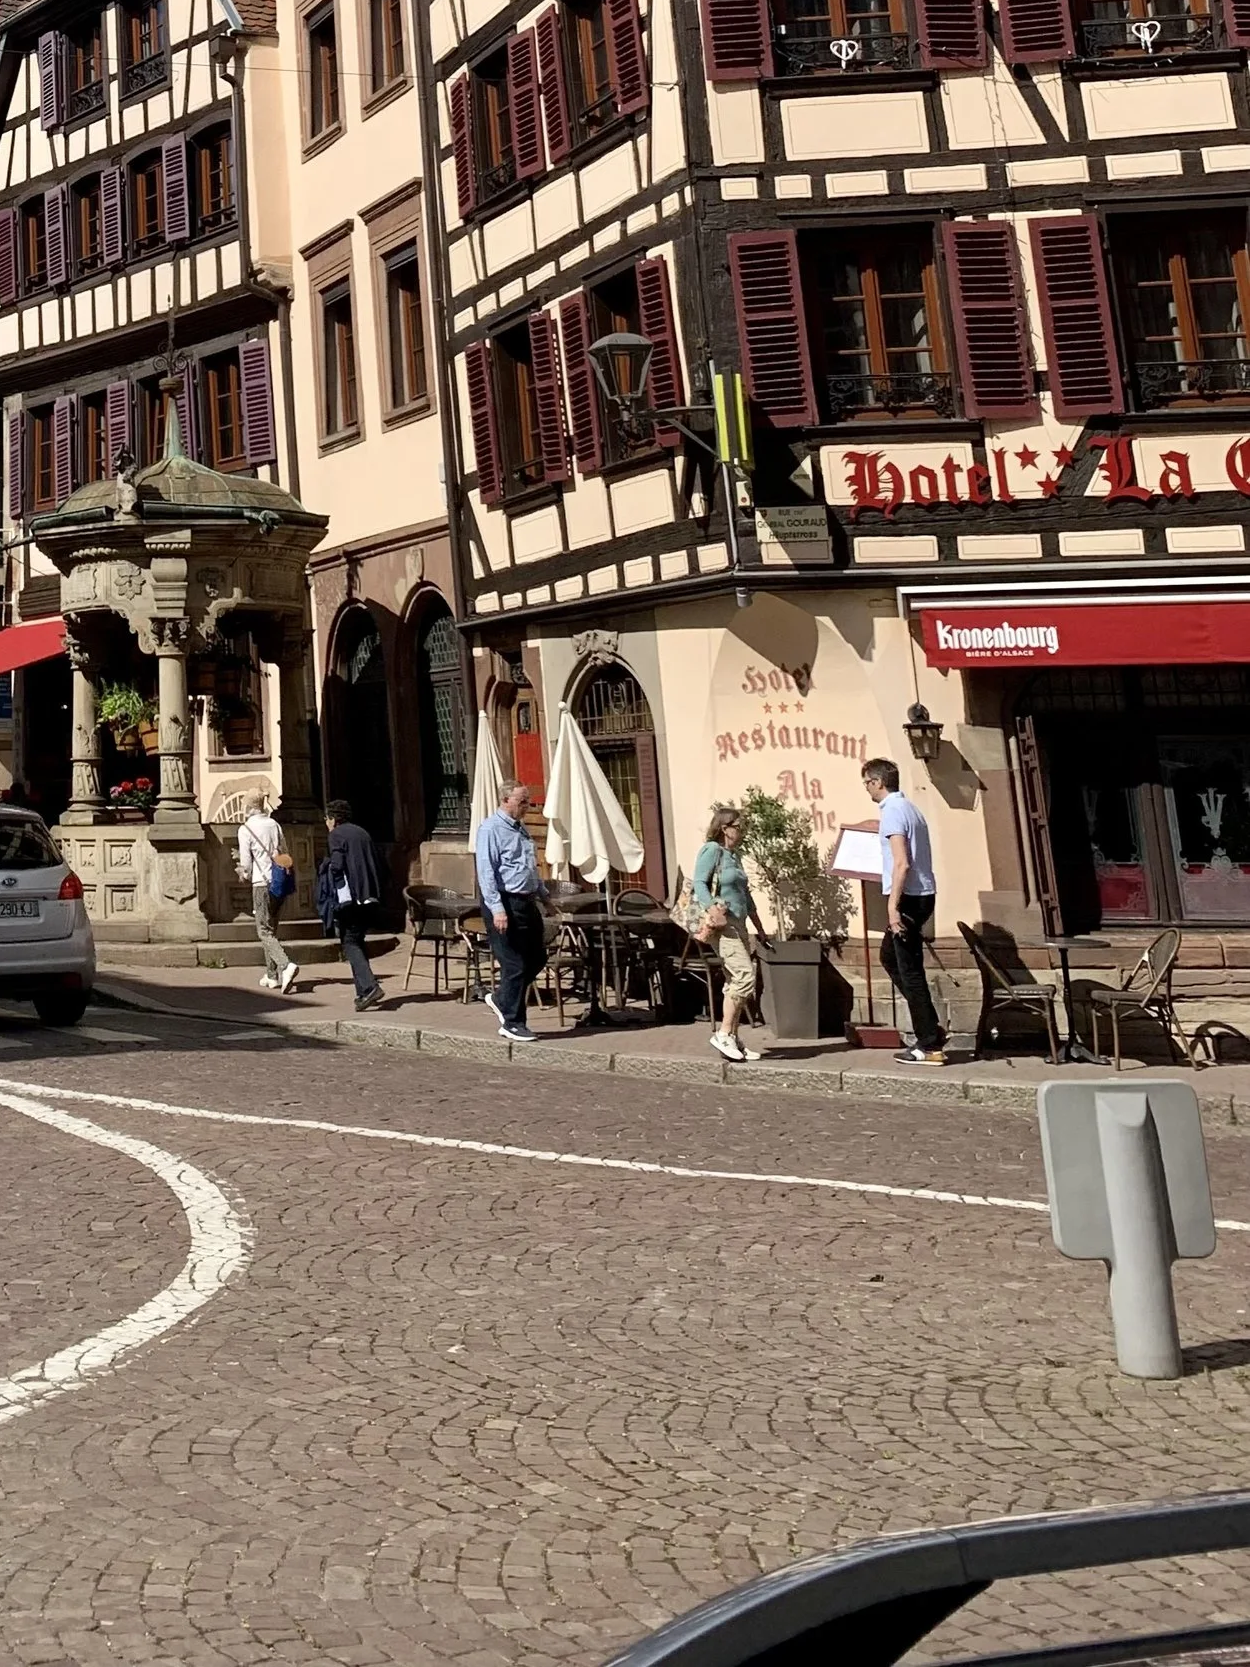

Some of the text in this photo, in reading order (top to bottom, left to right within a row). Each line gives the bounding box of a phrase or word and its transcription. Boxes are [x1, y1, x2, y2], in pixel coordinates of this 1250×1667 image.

[842, 447, 1015, 520] Hotel
[1087, 436, 1200, 504] La
[787, 518, 827, 527] GOURAUD
[936, 620, 1059, 654] Kronenbourg
[966, 649, 1034, 657] BIÈRE D'ALSACE
[741, 663, 816, 698] Hotel
[715, 719, 867, 763] Restaurant
